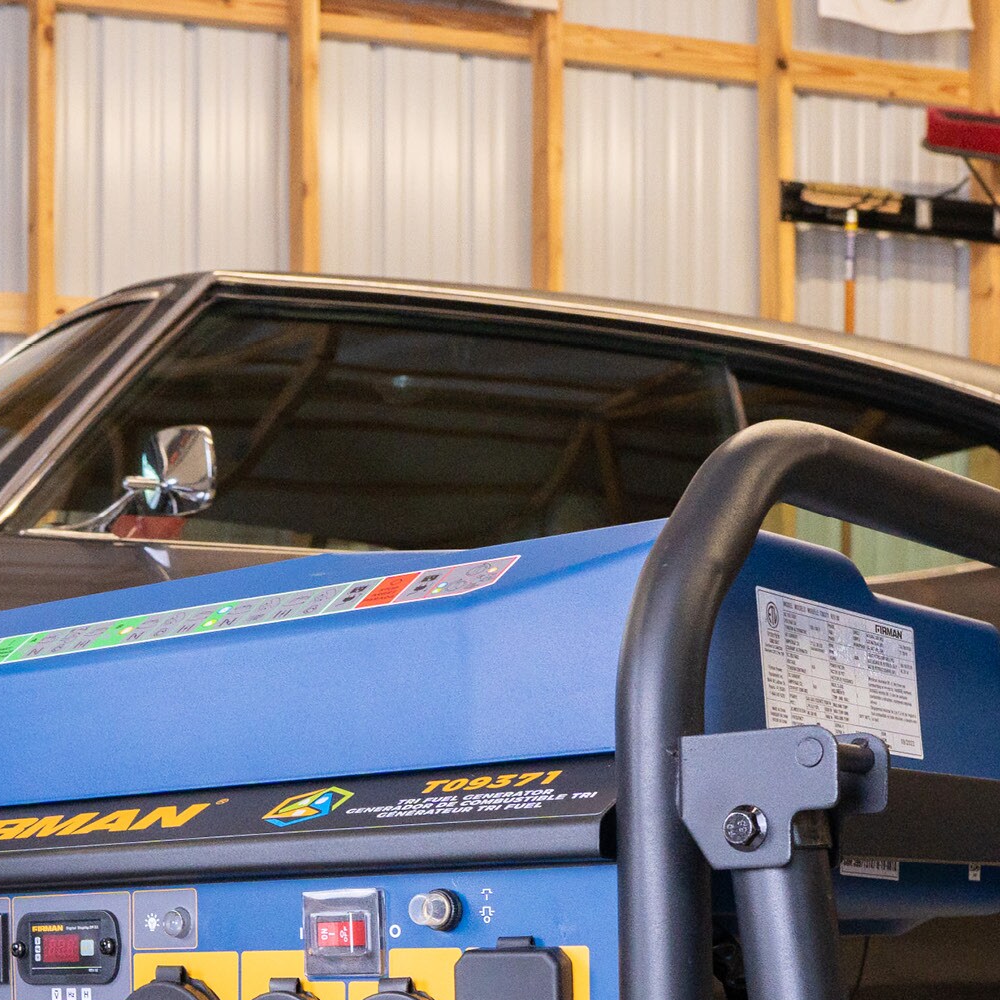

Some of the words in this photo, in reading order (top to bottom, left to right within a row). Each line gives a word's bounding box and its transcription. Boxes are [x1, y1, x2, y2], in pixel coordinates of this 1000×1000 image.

[875, 625, 902, 639] FIRMAN
[421, 770, 562, 794] T09371
[398, 797, 420, 805] TRI
[422, 795, 458, 804] FUEL
[462, 788, 554, 801] GENERATOR
[346, 803, 433, 815] GENERADOR
[454, 794, 570, 808] COMBUSTIBLE
[476, 804, 502, 812] TRI
[504, 801, 542, 810] FUEL
[321, 928, 328, 940] ON
